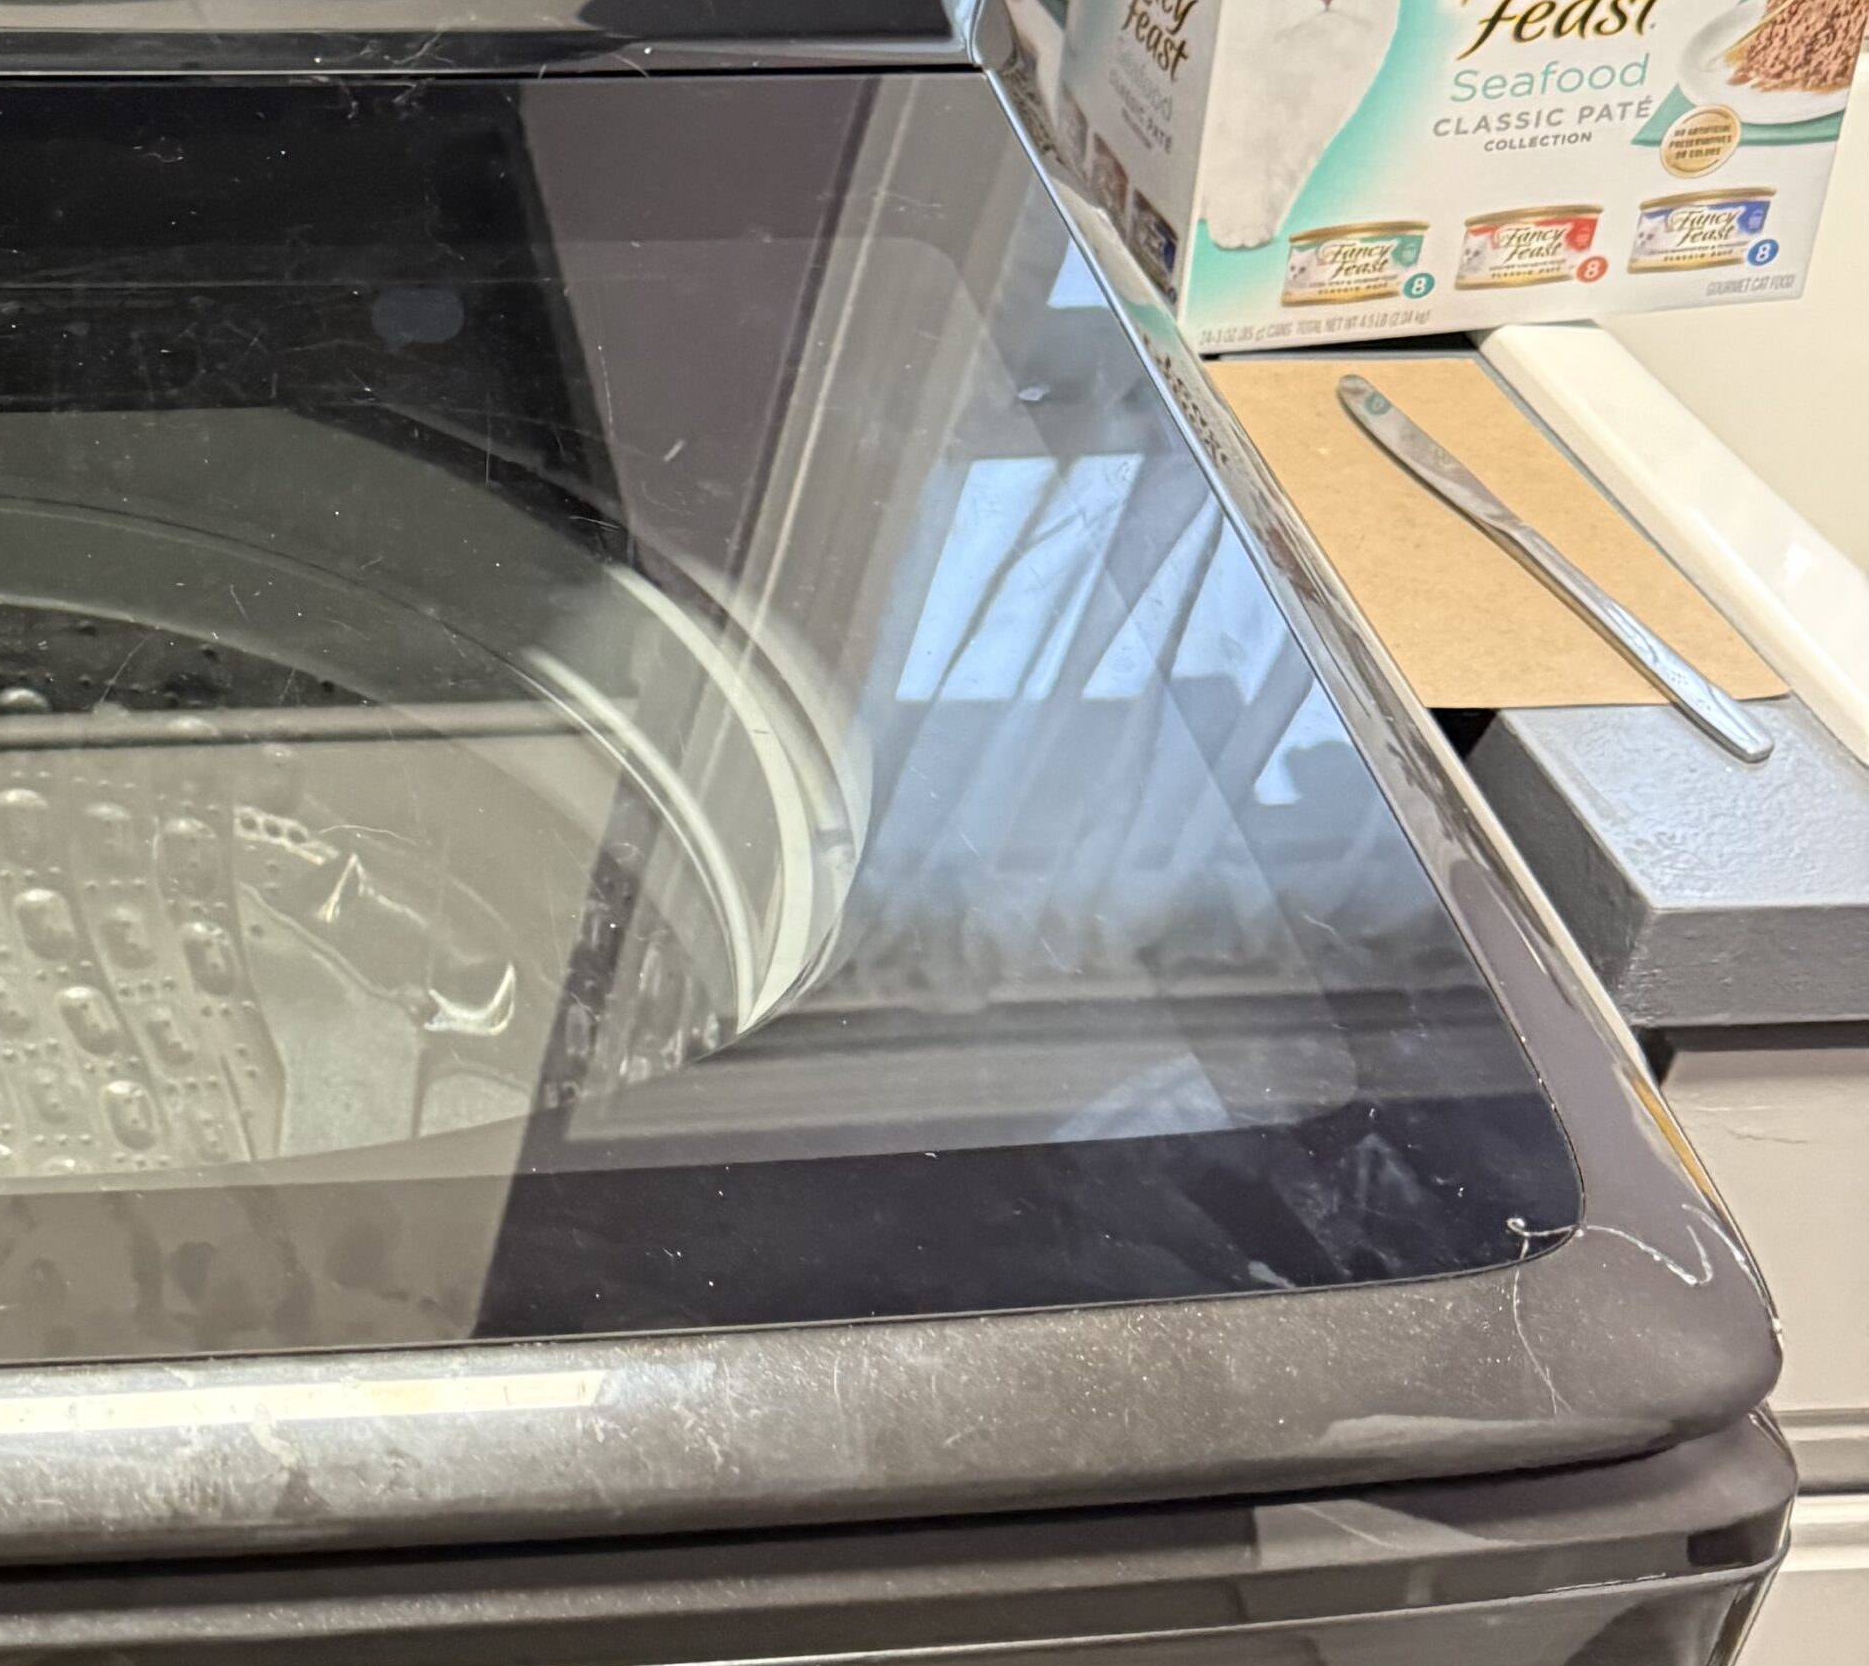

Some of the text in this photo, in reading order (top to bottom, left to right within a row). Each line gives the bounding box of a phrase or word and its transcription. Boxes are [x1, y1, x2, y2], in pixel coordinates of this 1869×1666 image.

[1450, 53, 1650, 103] Seafood
[1432, 95, 1652, 138] CLASSIC PATÉ
[1483, 131, 1593, 153] COLLECTION
[1671, 210, 1741, 232] Fancy
[1498, 227, 1567, 248] Fancy
[1677, 226, 1735, 247] Feast
[1504, 243, 1562, 264] Feast
[1756, 243, 1772, 263] 8
[1584, 259, 1601, 279] 8
[1409, 276, 1428, 296] 8
